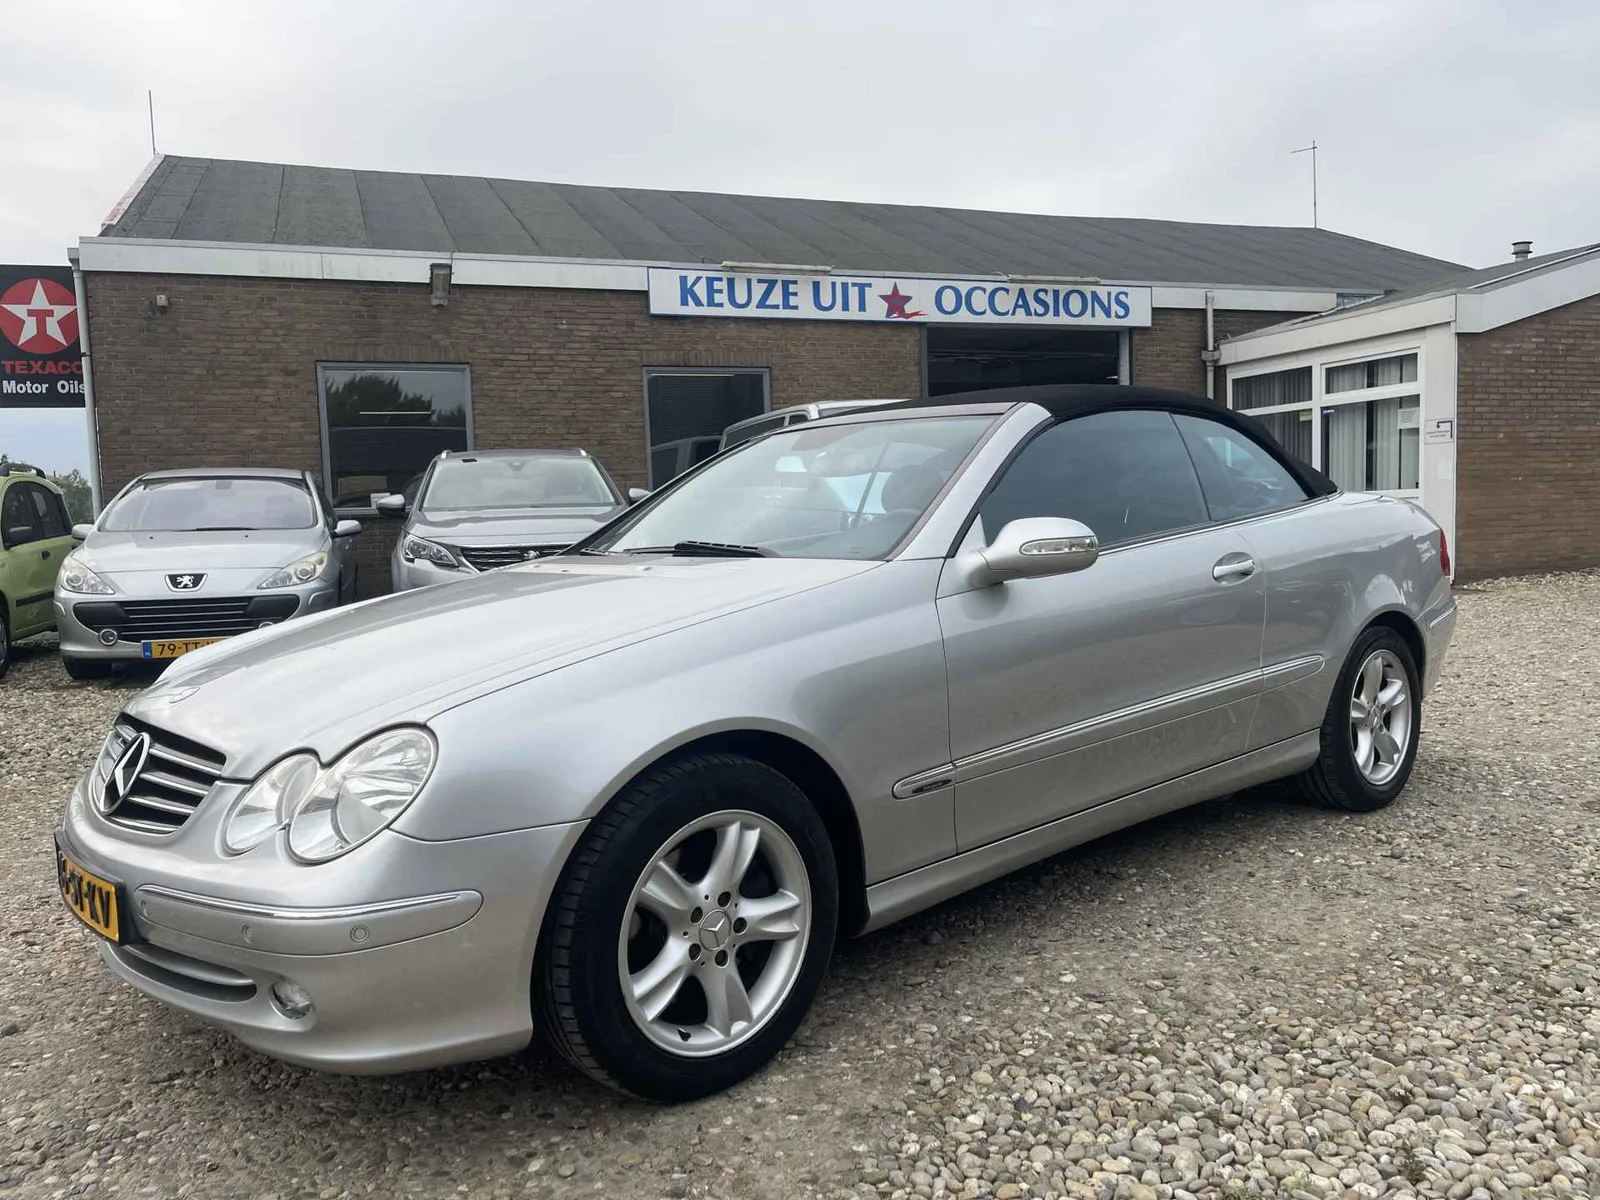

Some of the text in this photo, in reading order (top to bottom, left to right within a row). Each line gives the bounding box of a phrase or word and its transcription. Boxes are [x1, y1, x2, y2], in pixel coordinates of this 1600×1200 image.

[679, 275, 1130, 319] KEUZE UIT OCCASIONS
[2, 360, 82, 374] TEXACO
[3, 380, 85, 394] Motor Oils
